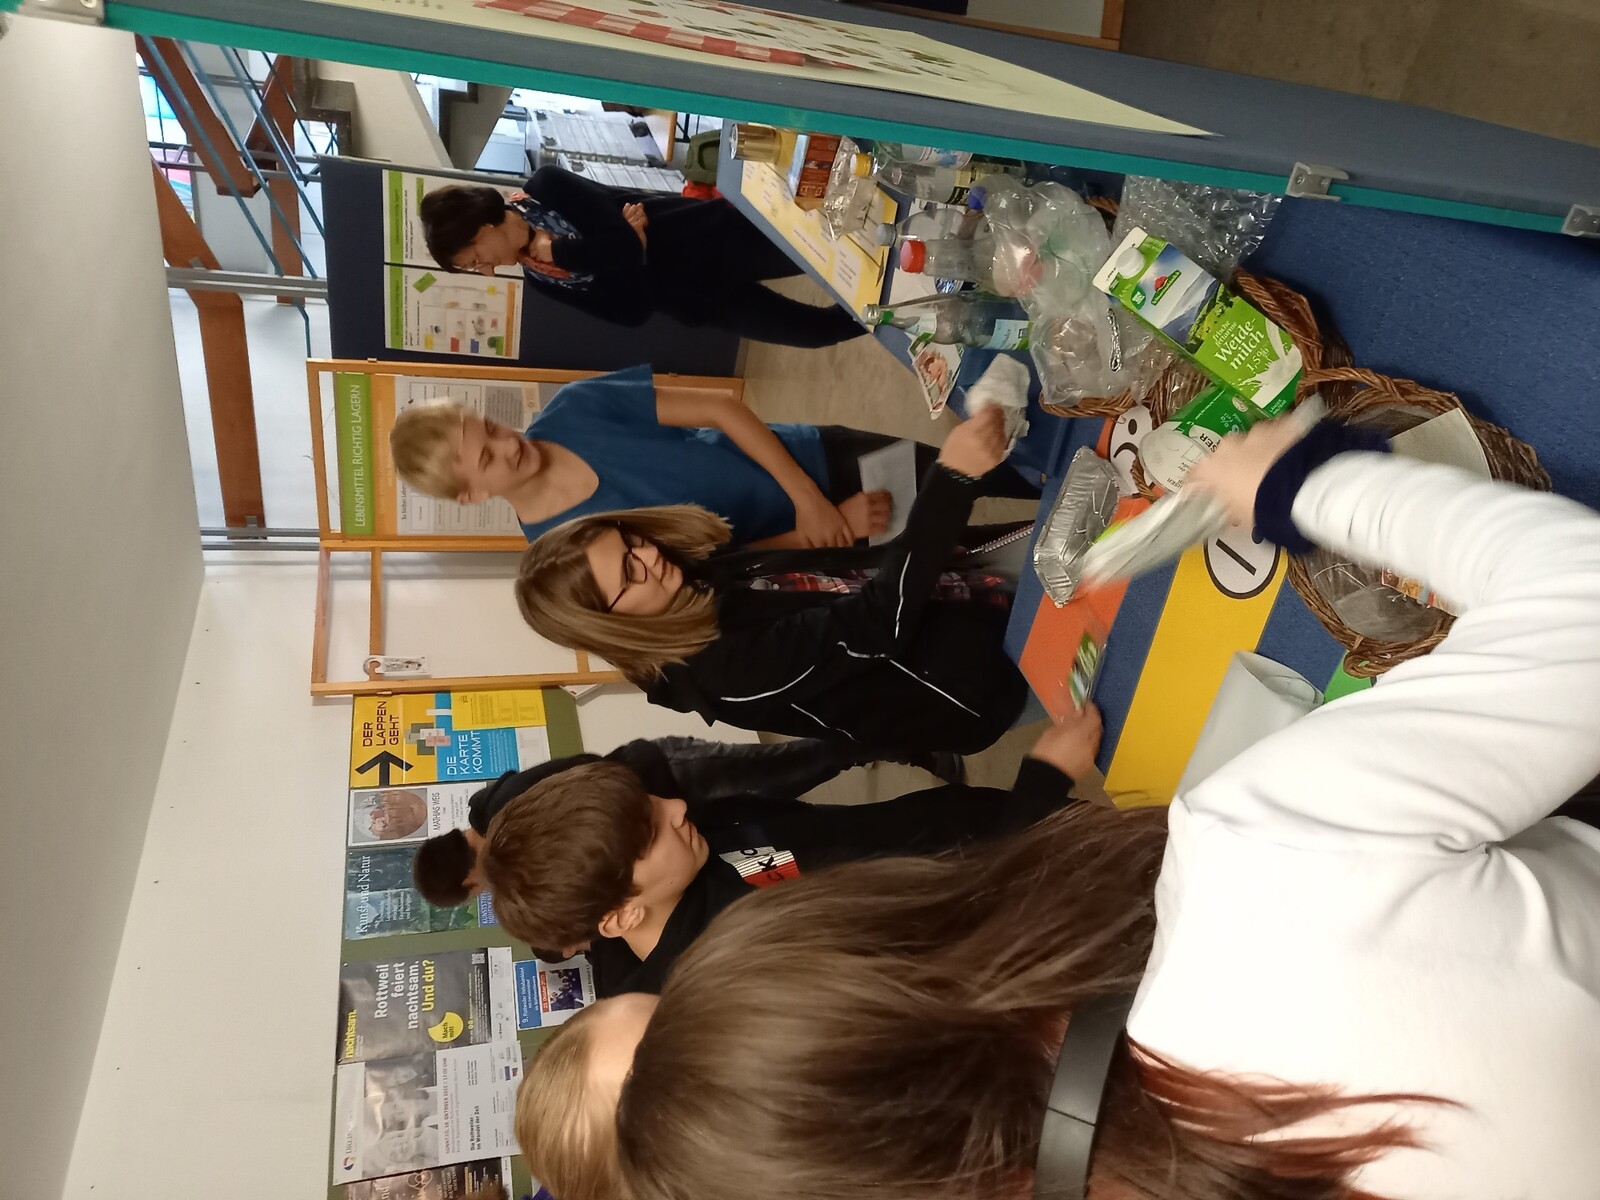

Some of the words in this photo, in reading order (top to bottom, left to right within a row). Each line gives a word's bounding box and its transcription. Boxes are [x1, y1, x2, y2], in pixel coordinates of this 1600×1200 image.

[1214, 318, 1256, 361] Weide-
[1230, 331, 1264, 369] milch
[350, 384, 361, 423] LAGERN
[352, 426, 363, 464] RICHTIG
[1200, 433, 1217, 453] SER
[354, 467, 365, 526] LEBENSMITTEL
[363, 722, 373, 747] DER
[376, 701, 386, 746] LAPPEN
[390, 715, 399, 745] GEHT
[447, 756, 457, 775] DIE
[458, 734, 470, 774] KARTE
[471, 730, 483, 774] KOMMT
[358, 855, 370, 882] Natur
[357, 884, 370, 902] und
[356, 906, 368, 933] Kunst
[391, 962, 405, 998] feiert
[422, 960, 434, 982] du?
[374, 964, 389, 1018] Rottweil
[406, 960, 419, 1029] nachtsam.
[421, 985, 434, 1012] Und
[344, 1009, 357, 1058] nachtsam.
